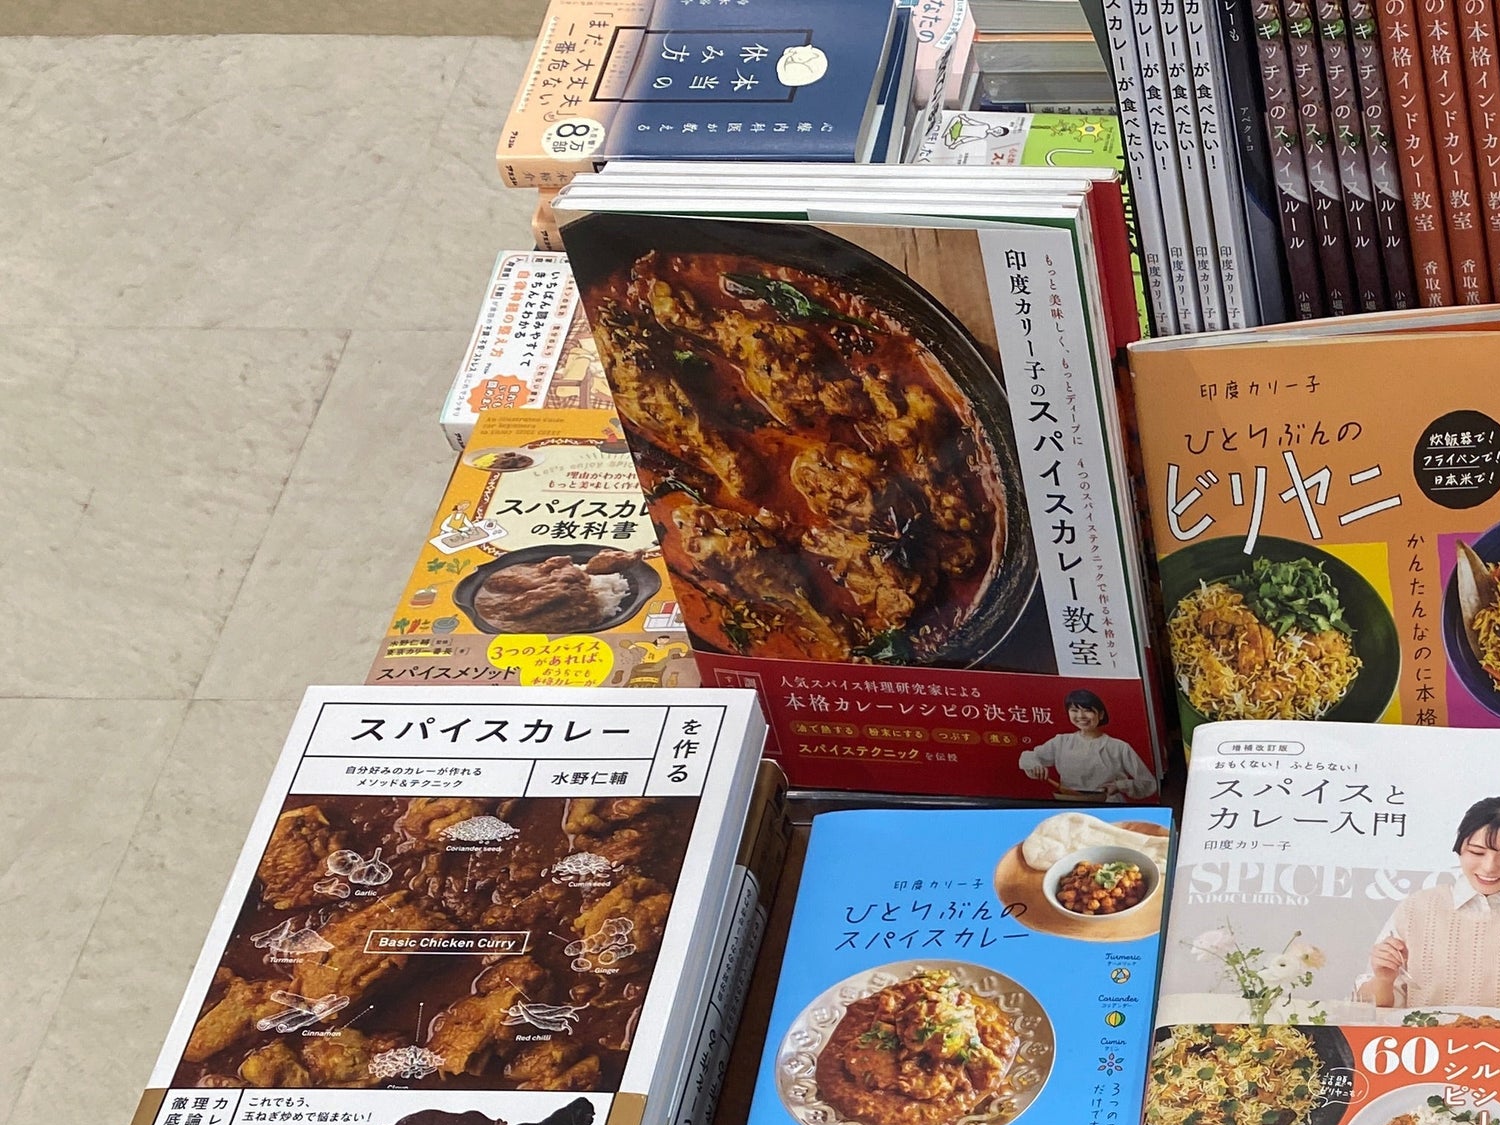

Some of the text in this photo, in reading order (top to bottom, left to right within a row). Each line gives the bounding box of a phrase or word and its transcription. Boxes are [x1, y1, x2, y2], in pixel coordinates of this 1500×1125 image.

[652, 67, 760, 91] 本当の
[1200, 375, 1321, 401] 印度カリー子
[1184, 421, 1364, 455] ひとりぶんの
[1167, 451, 1403, 556] ビリヤニ
[531, 520, 639, 540] の教科書
[784, 692, 1055, 725] 本格カレーレシピの決定版
[351, 716, 632, 746] スパイスカレー
[665, 718, 703, 784] を作る
[344, 765, 483, 778] 自分好みのカレーが作れる
[550, 769, 628, 787] 水野仁輔
[1214, 759, 1359, 773] おもくない! ふとらない!
[1208, 777, 1407, 806] スパイスと
[1208, 807, 1407, 838] カレー入門
[1204, 839, 1292, 852] 印度カリー子
[845, 900, 1028, 923] ひとりぶんの
[379, 937, 517, 951] Basic Chicken Curry
[834, 927, 1031, 952] スパイスカレー
[1362, 1037, 1440, 1076] 60
[1444, 1038, 1470, 1105] レシピ
[247, 1096, 312, 1110] これでもう、
